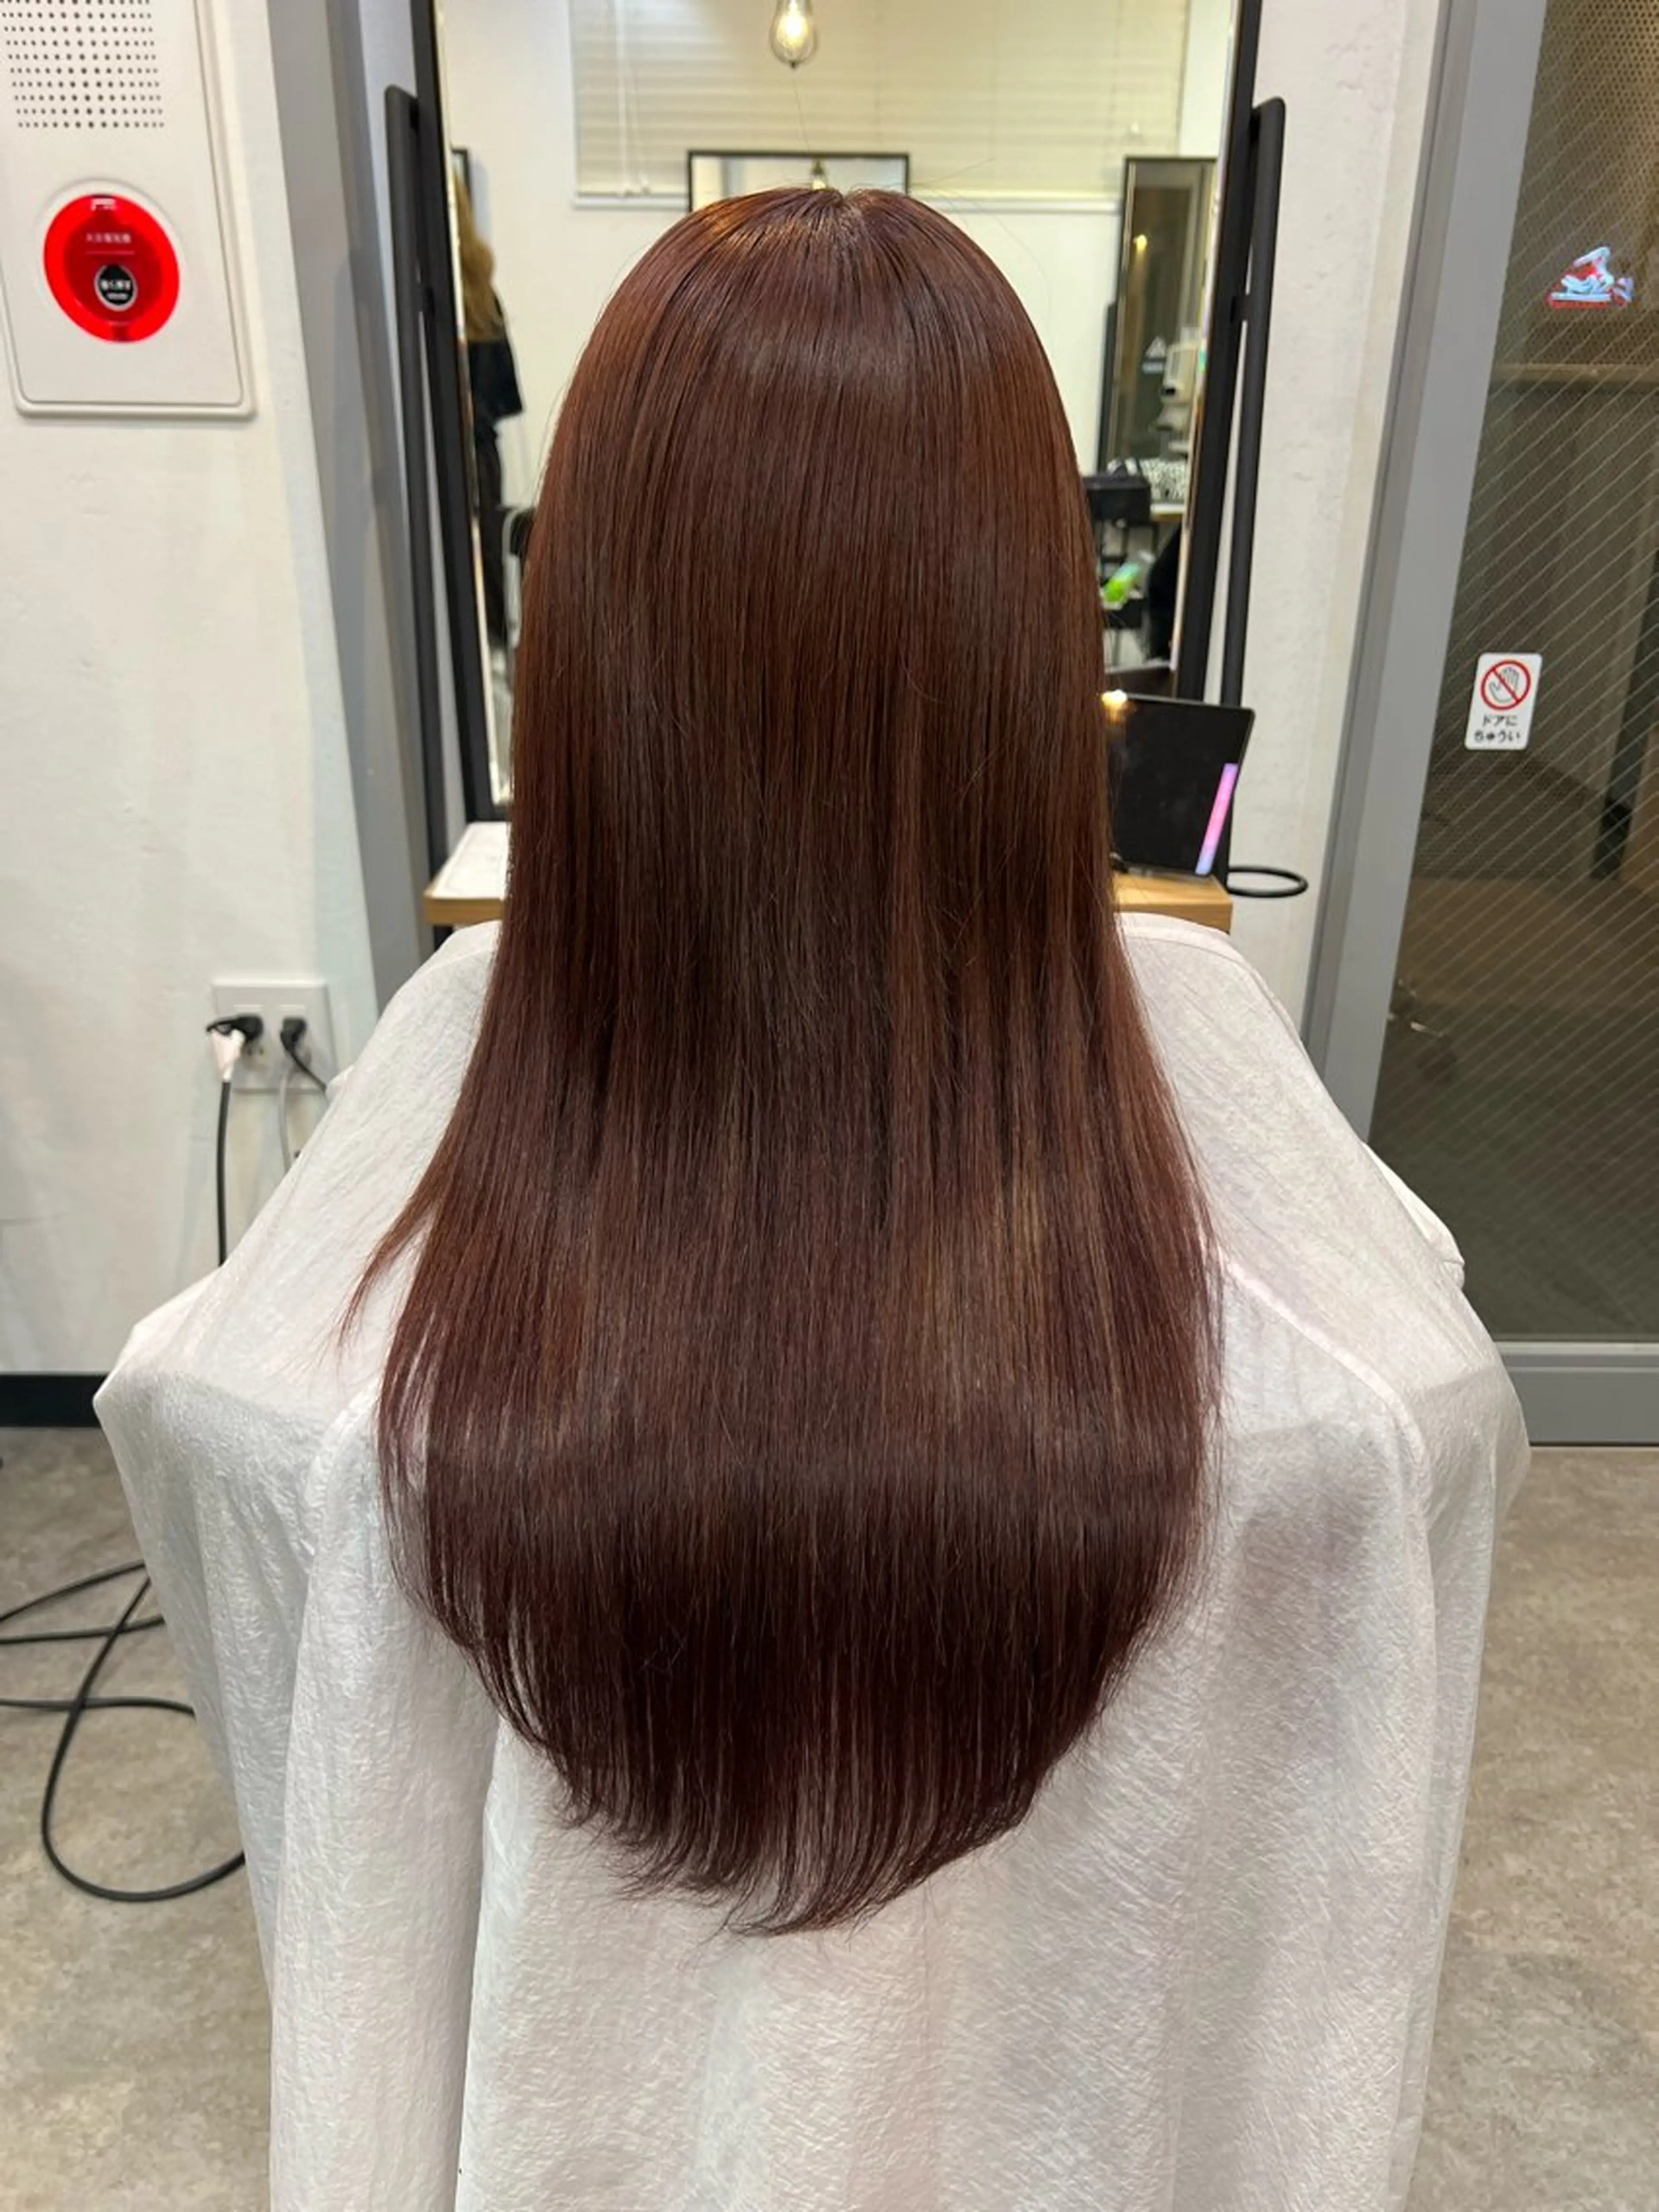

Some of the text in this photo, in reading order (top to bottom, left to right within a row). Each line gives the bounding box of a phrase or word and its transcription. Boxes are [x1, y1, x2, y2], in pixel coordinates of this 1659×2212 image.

[1482, 713, 1518, 727] ドアに
[1474, 730, 1520, 743] ちゅうい
